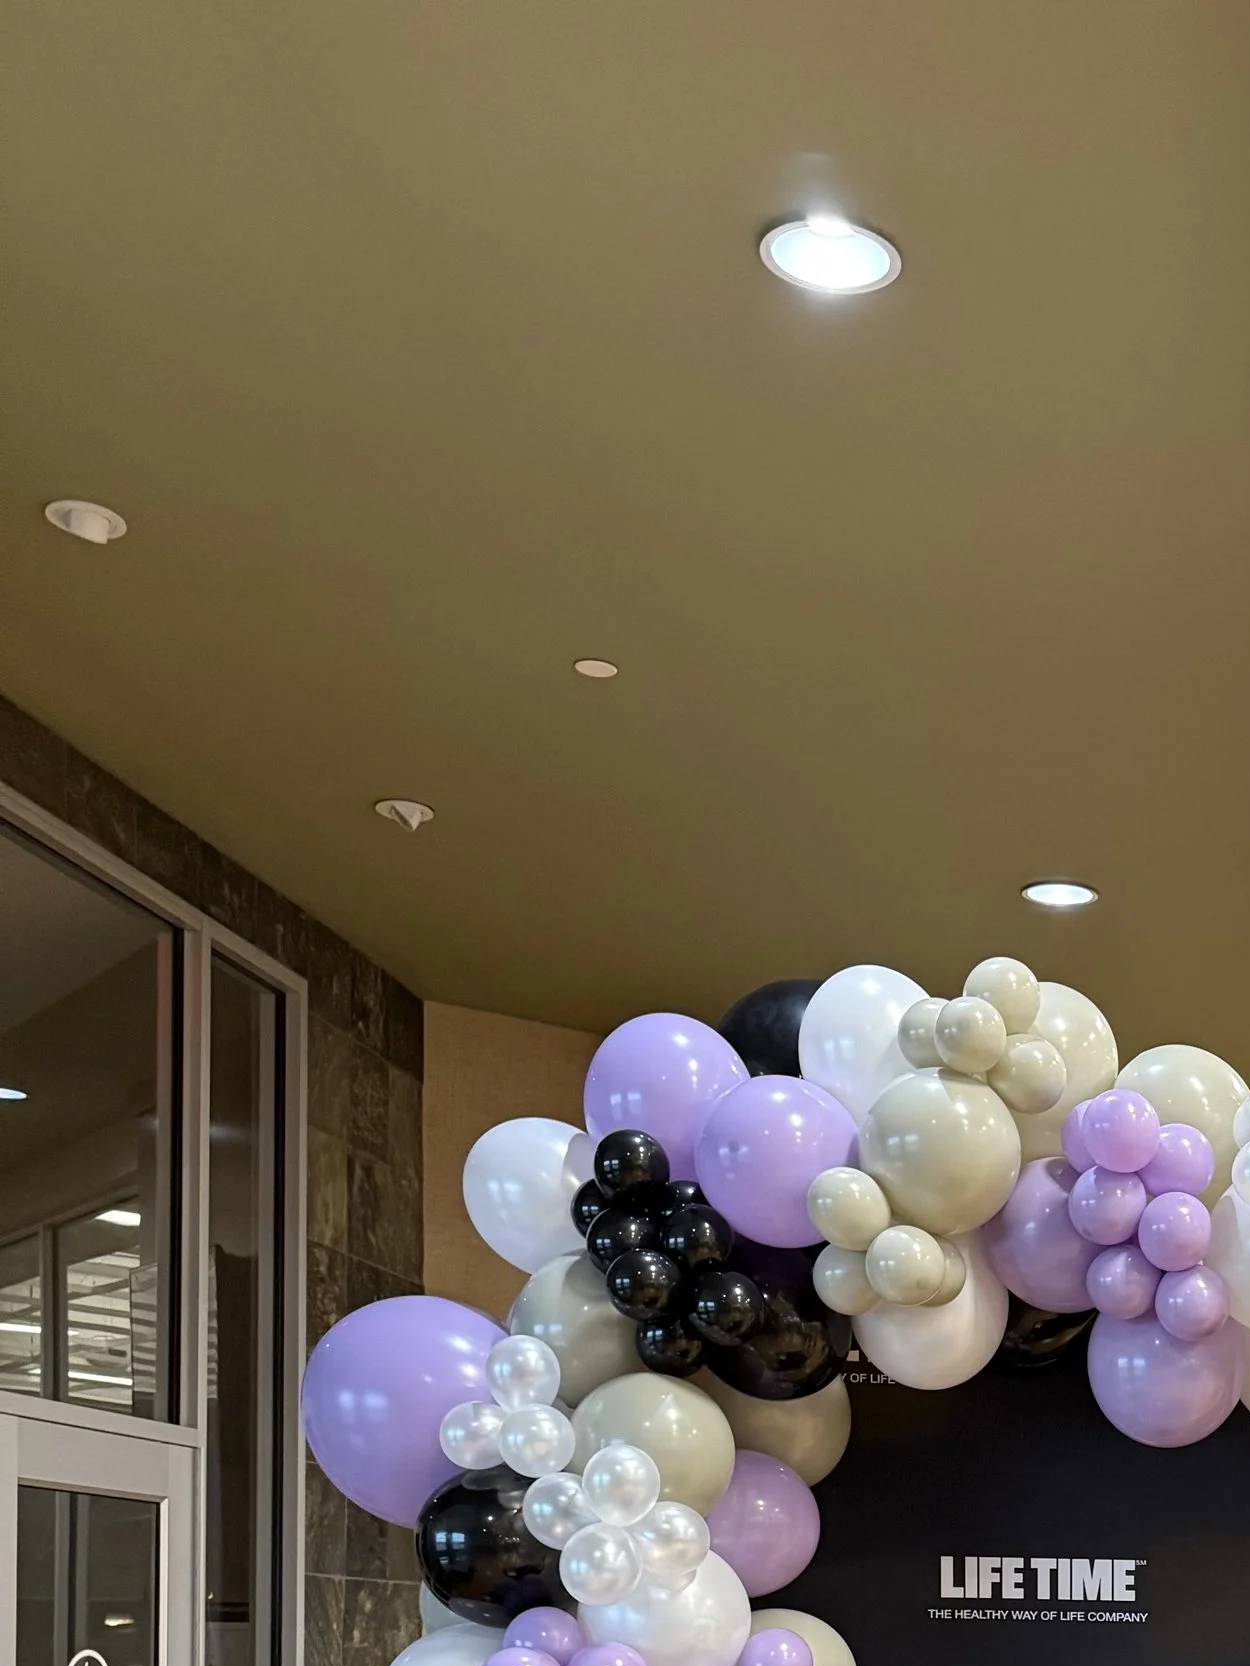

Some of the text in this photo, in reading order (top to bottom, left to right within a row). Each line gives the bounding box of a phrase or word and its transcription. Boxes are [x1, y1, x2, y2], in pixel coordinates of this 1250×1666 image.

[849, 1373, 868, 1383] OF
[941, 1556, 1024, 1599] LIFE
[1031, 1558, 1135, 1601] TIME
[927, 1608, 1149, 1623] THE HEALTHY WAY OF LIFE COMPANY
